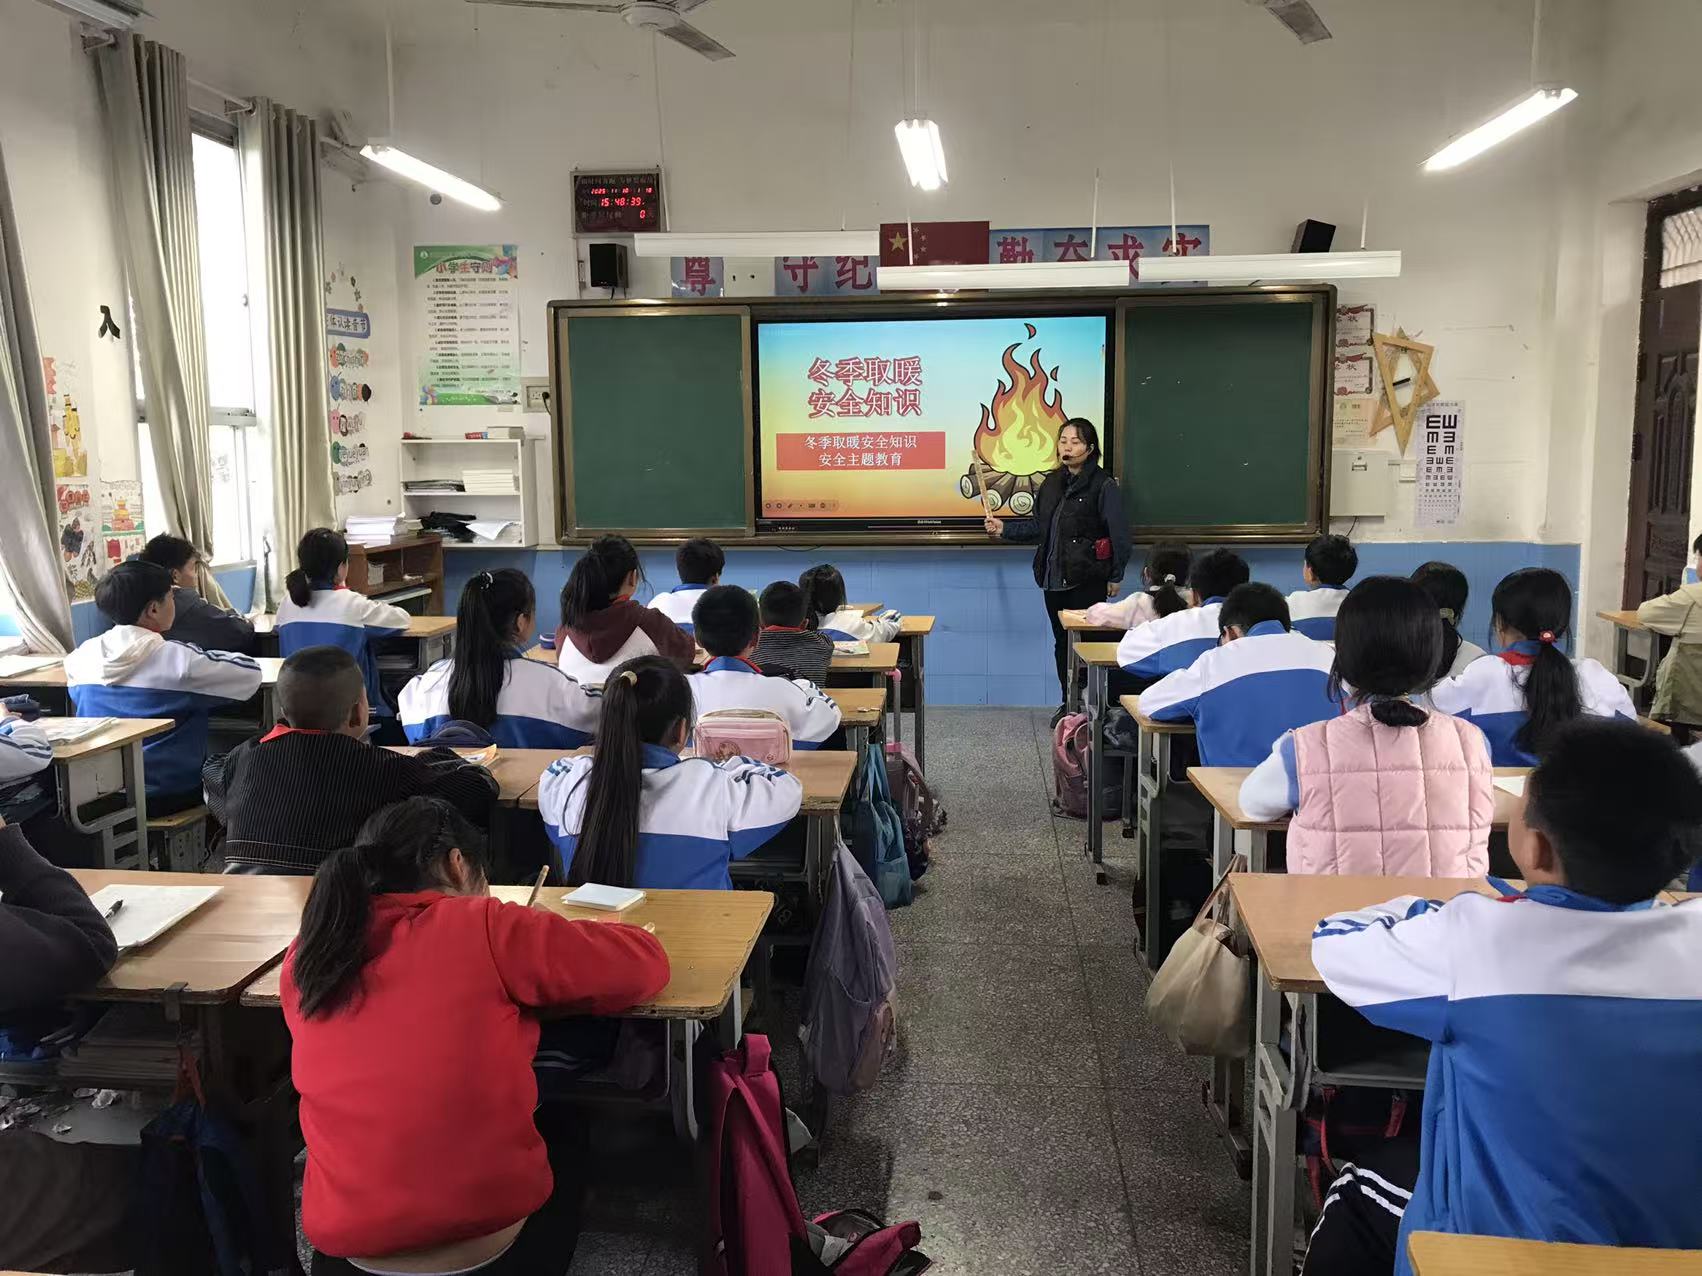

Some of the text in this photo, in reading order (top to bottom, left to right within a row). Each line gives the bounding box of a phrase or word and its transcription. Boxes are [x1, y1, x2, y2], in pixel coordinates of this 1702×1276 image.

[435, 260, 493, 274] 小学生守则
[808, 356, 923, 387] 冬季取暖
[808, 387, 922, 418] 安全知识
[804, 435, 918, 450] 冬季取暖安全知识
[818, 452, 903, 467] 安全主题教育
